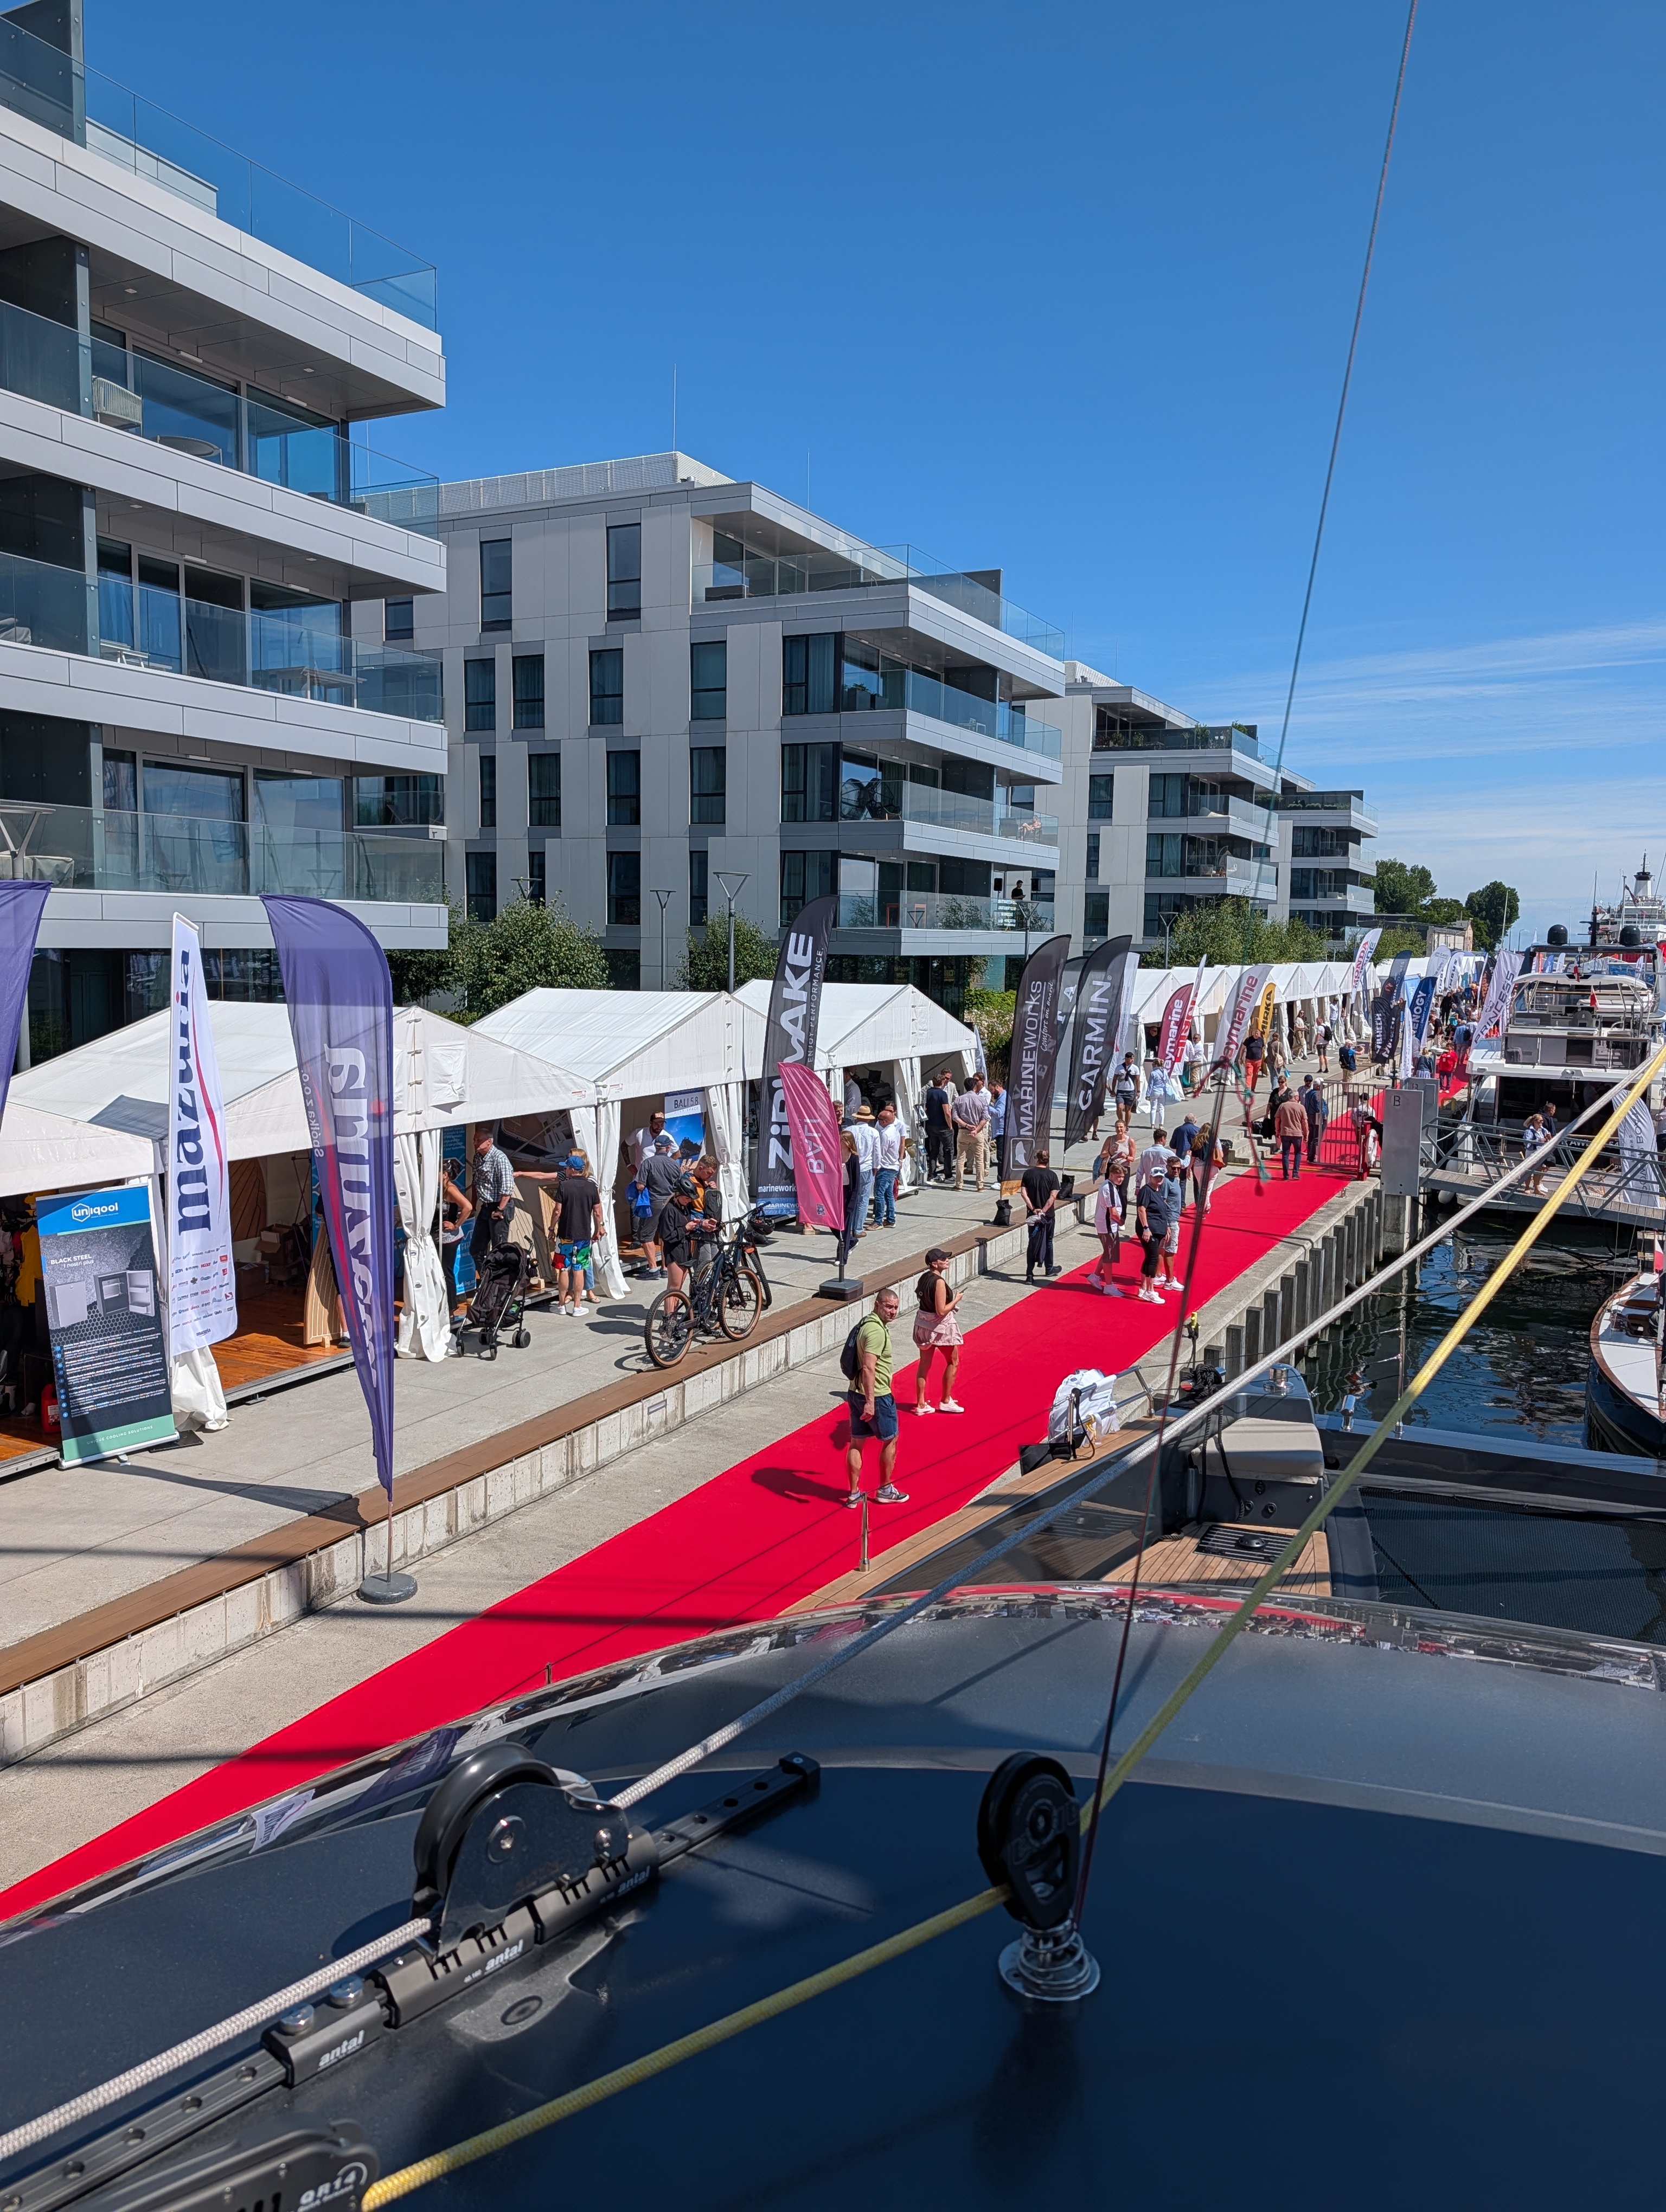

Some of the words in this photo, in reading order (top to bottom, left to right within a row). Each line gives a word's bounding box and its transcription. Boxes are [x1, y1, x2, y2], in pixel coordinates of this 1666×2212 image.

[810, 948, 823, 1027] PERFORMANCE.
[1260, 990, 1273, 1035] MIRKA
[1475, 970, 1515, 1044] PRINCESS
[1079, 980, 1111, 1111] GARMIN
[176, 949, 212, 1236] mazuria
[674, 1098, 689, 1109] BALI
[1393, 1095, 1401, 1107] B
[804, 1118, 824, 1174] BALI
[758, 1184, 798, 1192] marinework
[74, 1202, 119, 1217] uniqool
[50, 1256, 72, 1265] BLACK
[73, 1253, 92, 1262] STEEL
[87, 1437, 105, 1445] UNIQUE
[106, 1431, 127, 1440] COOLING
[128, 1425, 153, 1435] SOLUTIONS
[618, 1865, 650, 1894] antal
[485, 1938, 524, 1971] antal
[318, 2029, 364, 2067] antal
